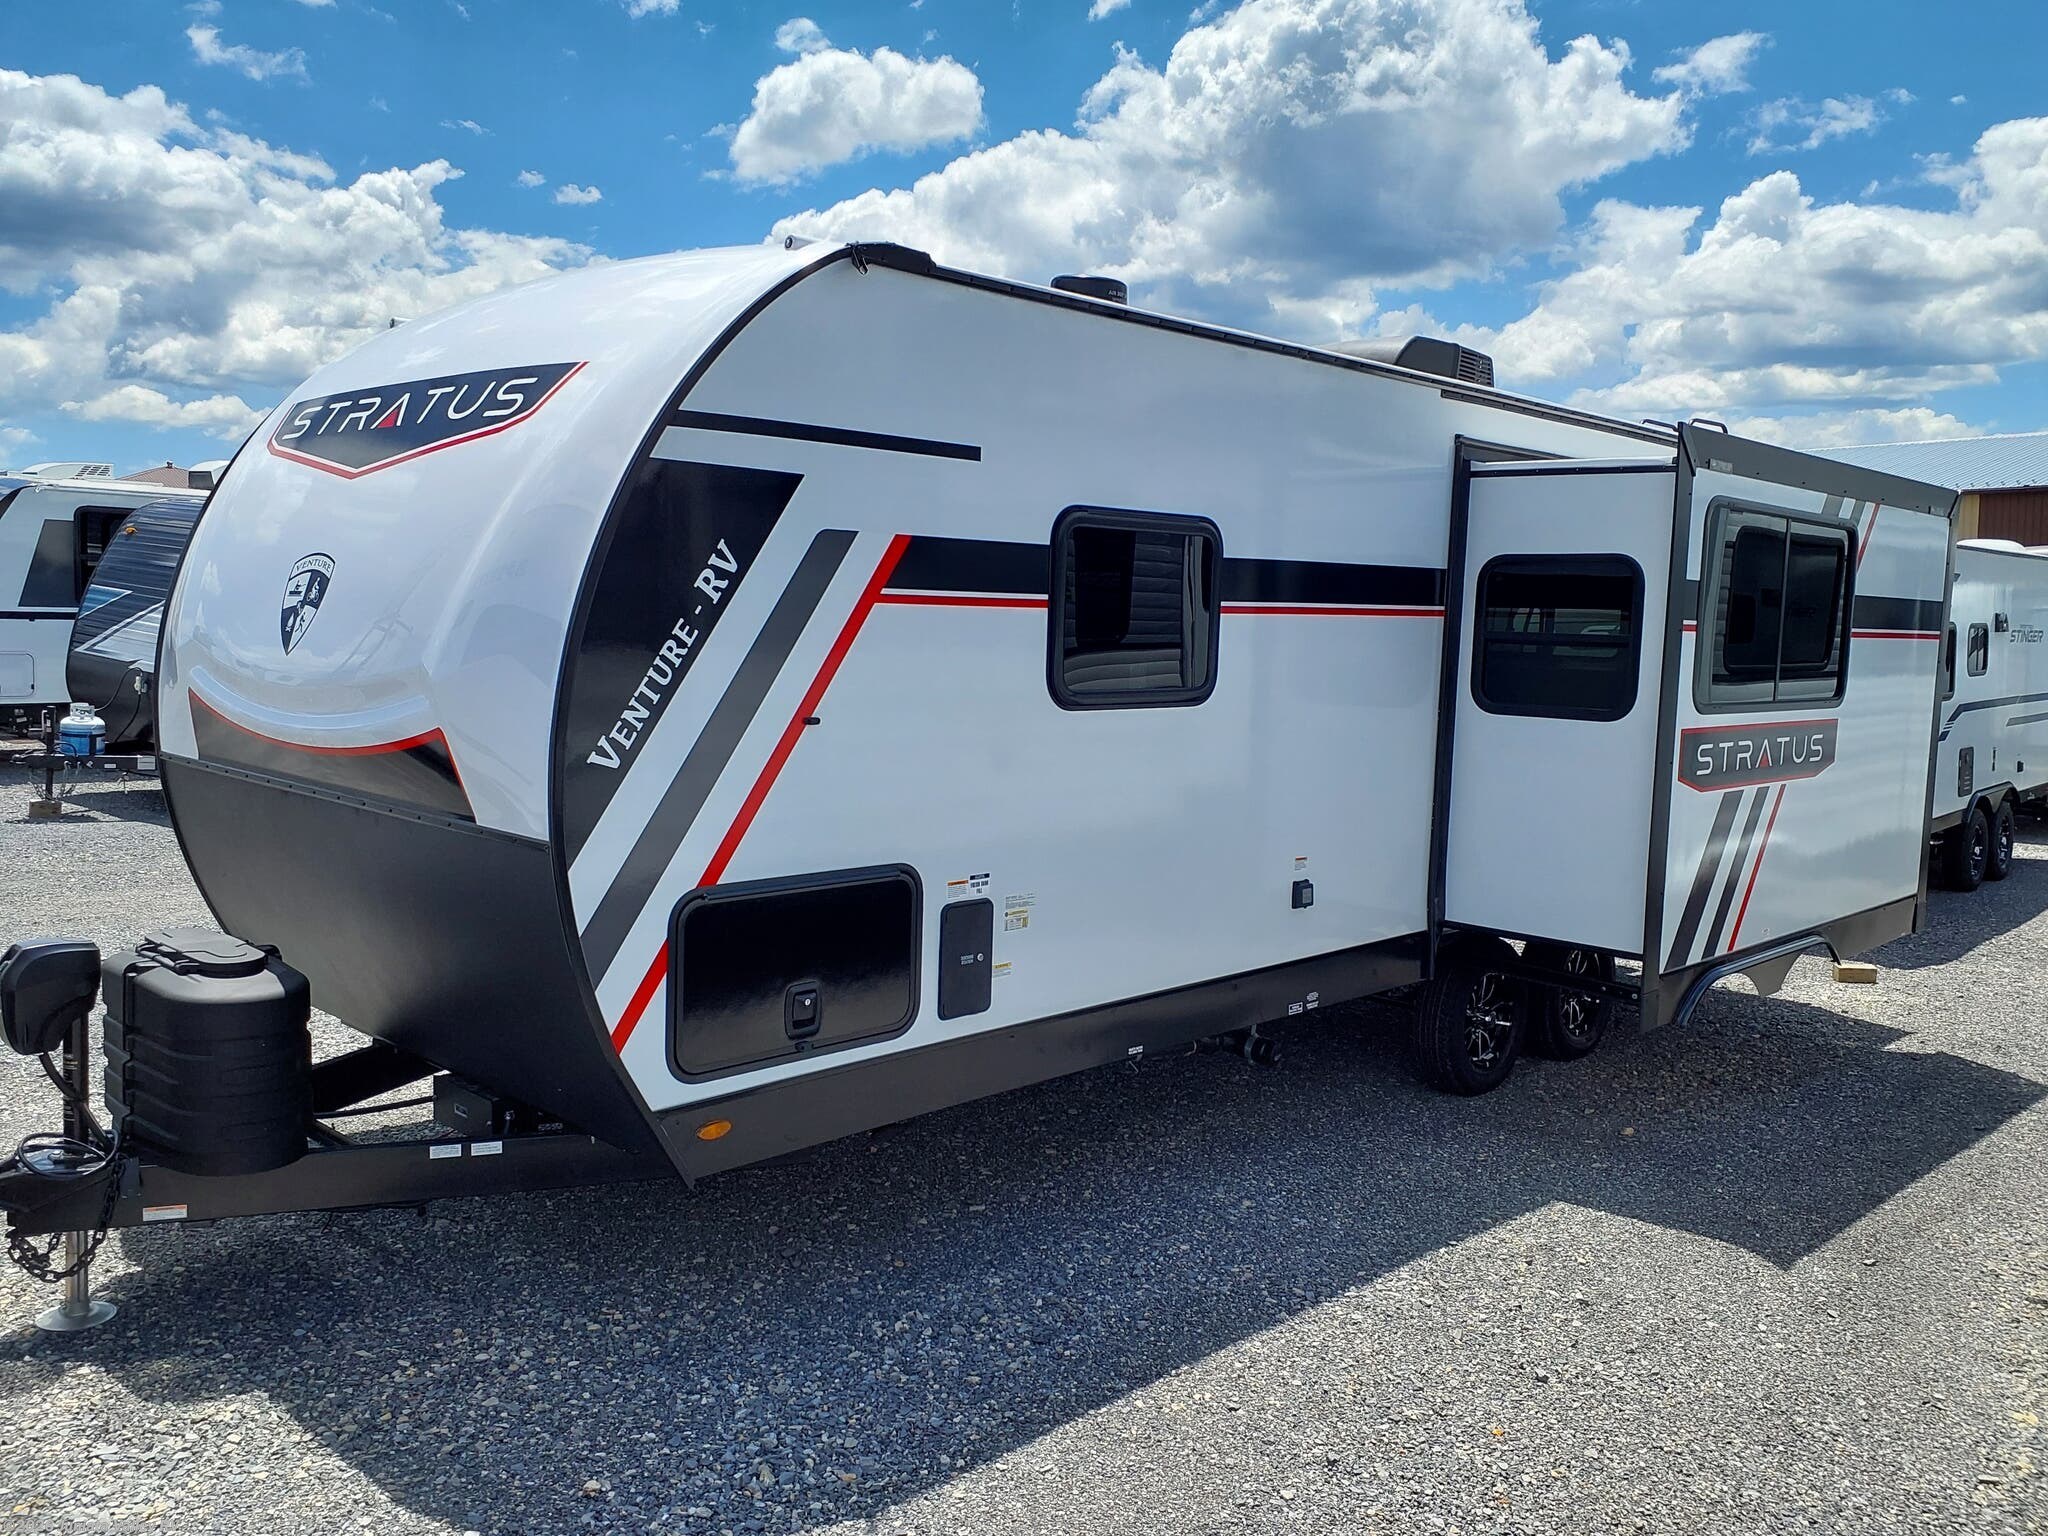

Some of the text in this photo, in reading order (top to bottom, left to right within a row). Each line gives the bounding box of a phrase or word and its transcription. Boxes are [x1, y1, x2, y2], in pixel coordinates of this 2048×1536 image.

[281, 376, 540, 440] STRATUS
[296, 558, 332, 573] VENTURE
[586, 617, 699, 770] VENTURE
[693, 538, 739, 605] RV
[1696, 734, 1824, 776] STRATUS
